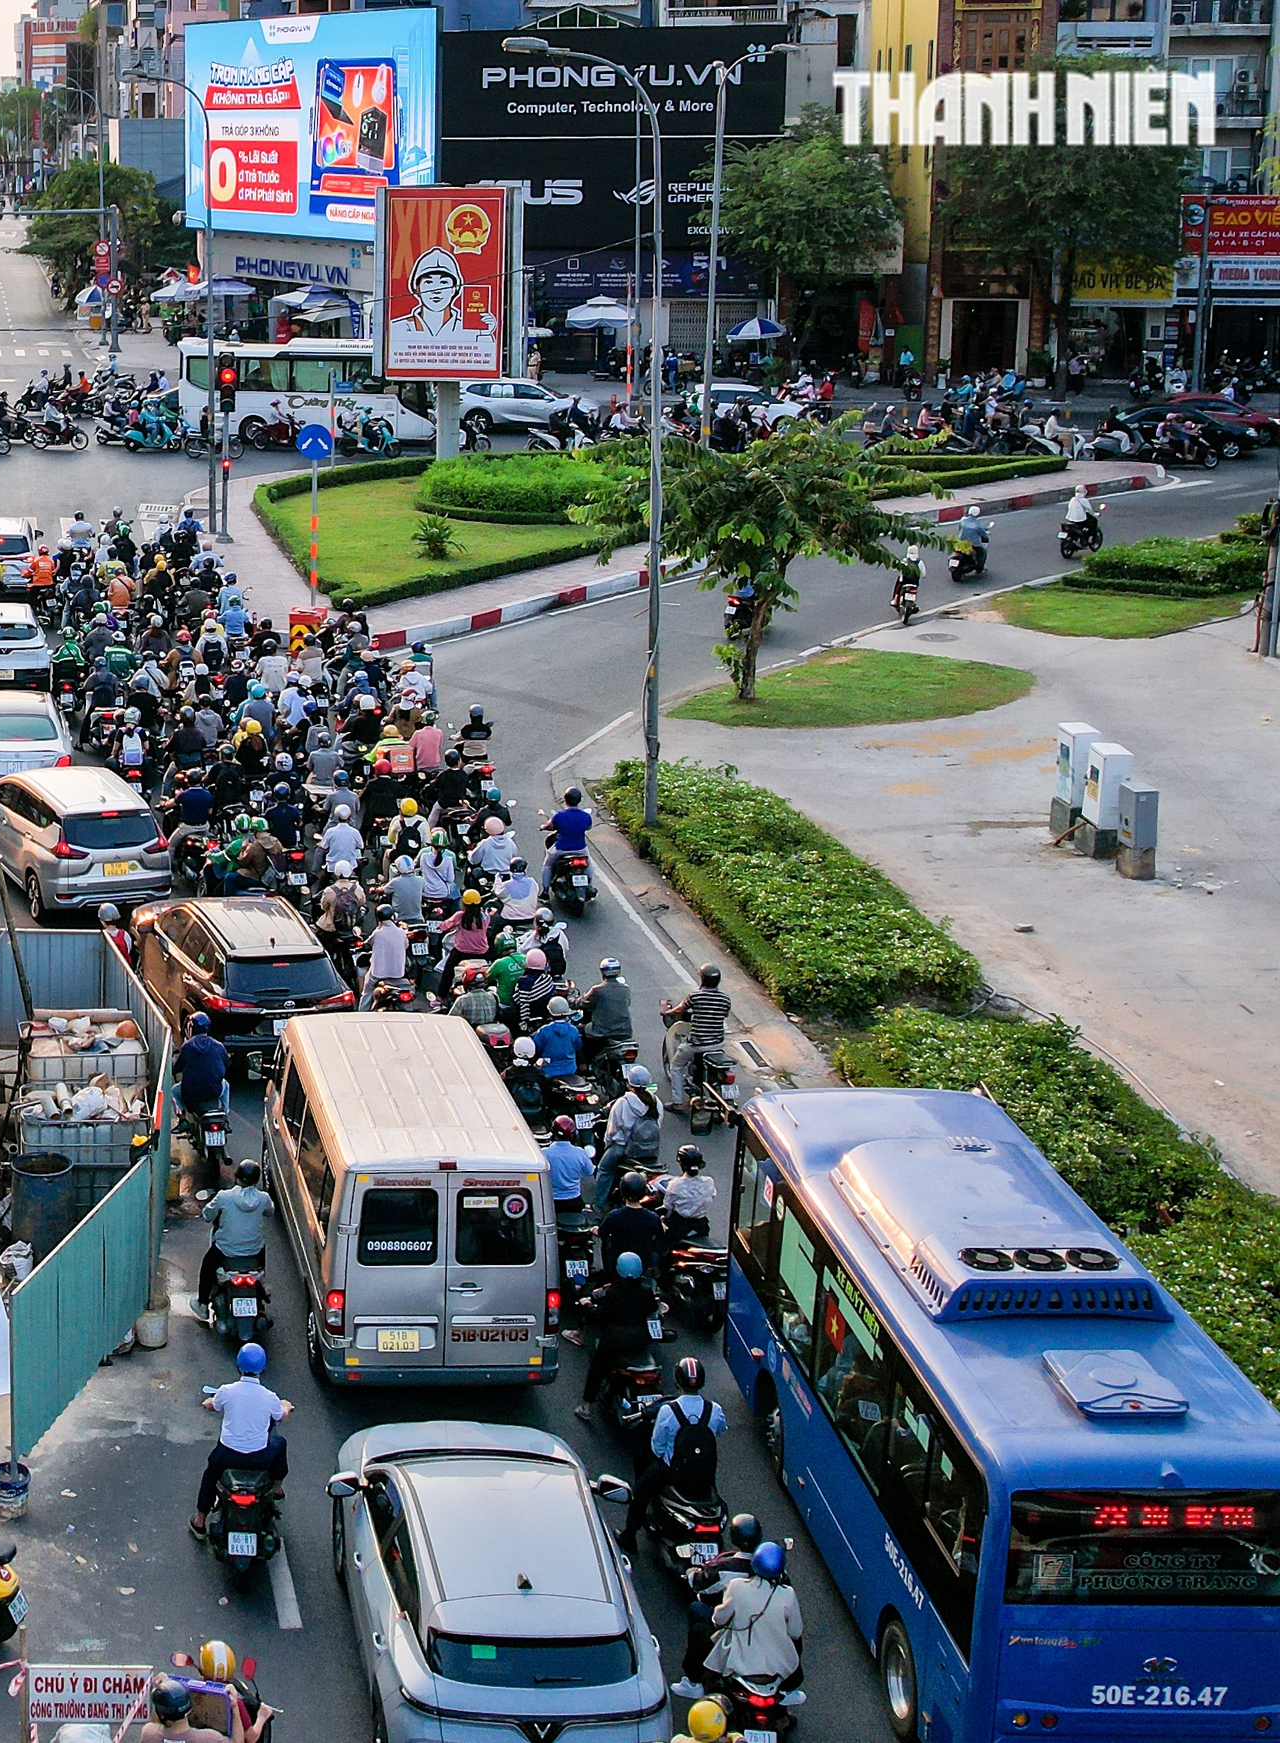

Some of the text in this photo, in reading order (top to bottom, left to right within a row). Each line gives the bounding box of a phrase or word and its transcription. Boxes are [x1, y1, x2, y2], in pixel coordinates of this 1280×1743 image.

[276, 25, 311, 33] PHONGVU.VN
[211, 61, 238, 86] TRỌN
[271, 56, 294, 83] CẤP
[482, 64, 742, 89] PHONGVU.VN
[212, 90, 245, 105] KHÔNG
[245, 90, 264, 104] TRẢ
[507, 99, 714, 116] Computer, Technology & More
[222, 123, 280, 137] TRẢ GÓP 3 KHÔNG
[238, 151, 248, 163] %
[261, 150, 278, 164] Suất
[210, 147, 237, 203] 0
[245, 168, 256, 183] Trả
[257, 169, 280, 183] Trước
[258, 187, 275, 202] Phát
[276, 189, 293, 203] Sinh
[1213, 211, 1252, 226] SAO
[1222, 230, 1236, 238] LÁI
[1251, 229, 1268, 238] CÁC
[235, 256, 349, 285] PHONGVU.VN
[373, 1176, 432, 1187] Mercedes
[367, 1240, 433, 1252] 0908806607
[389, 1331, 408, 1341] 51B
[382, 1341, 415, 1351] 021.03
[1123, 1552, 1221, 1569] CÔNG TY
[884, 1532, 925, 1611] 50E-216.47
[1079, 1572, 1257, 1590] PHƯƠNG TRANG
[34, 1672, 146, 1699] CHÚ Ý ĐI CHẬM
[1090, 1684, 1229, 1706] 50E-216.47
[30, 1699, 52, 1718] CÔNG
[54, 1698, 86, 1719] TRƯỜNG
[87, 1702, 110, 1719] ĐANG
[111, 1702, 125, 1719] THI
